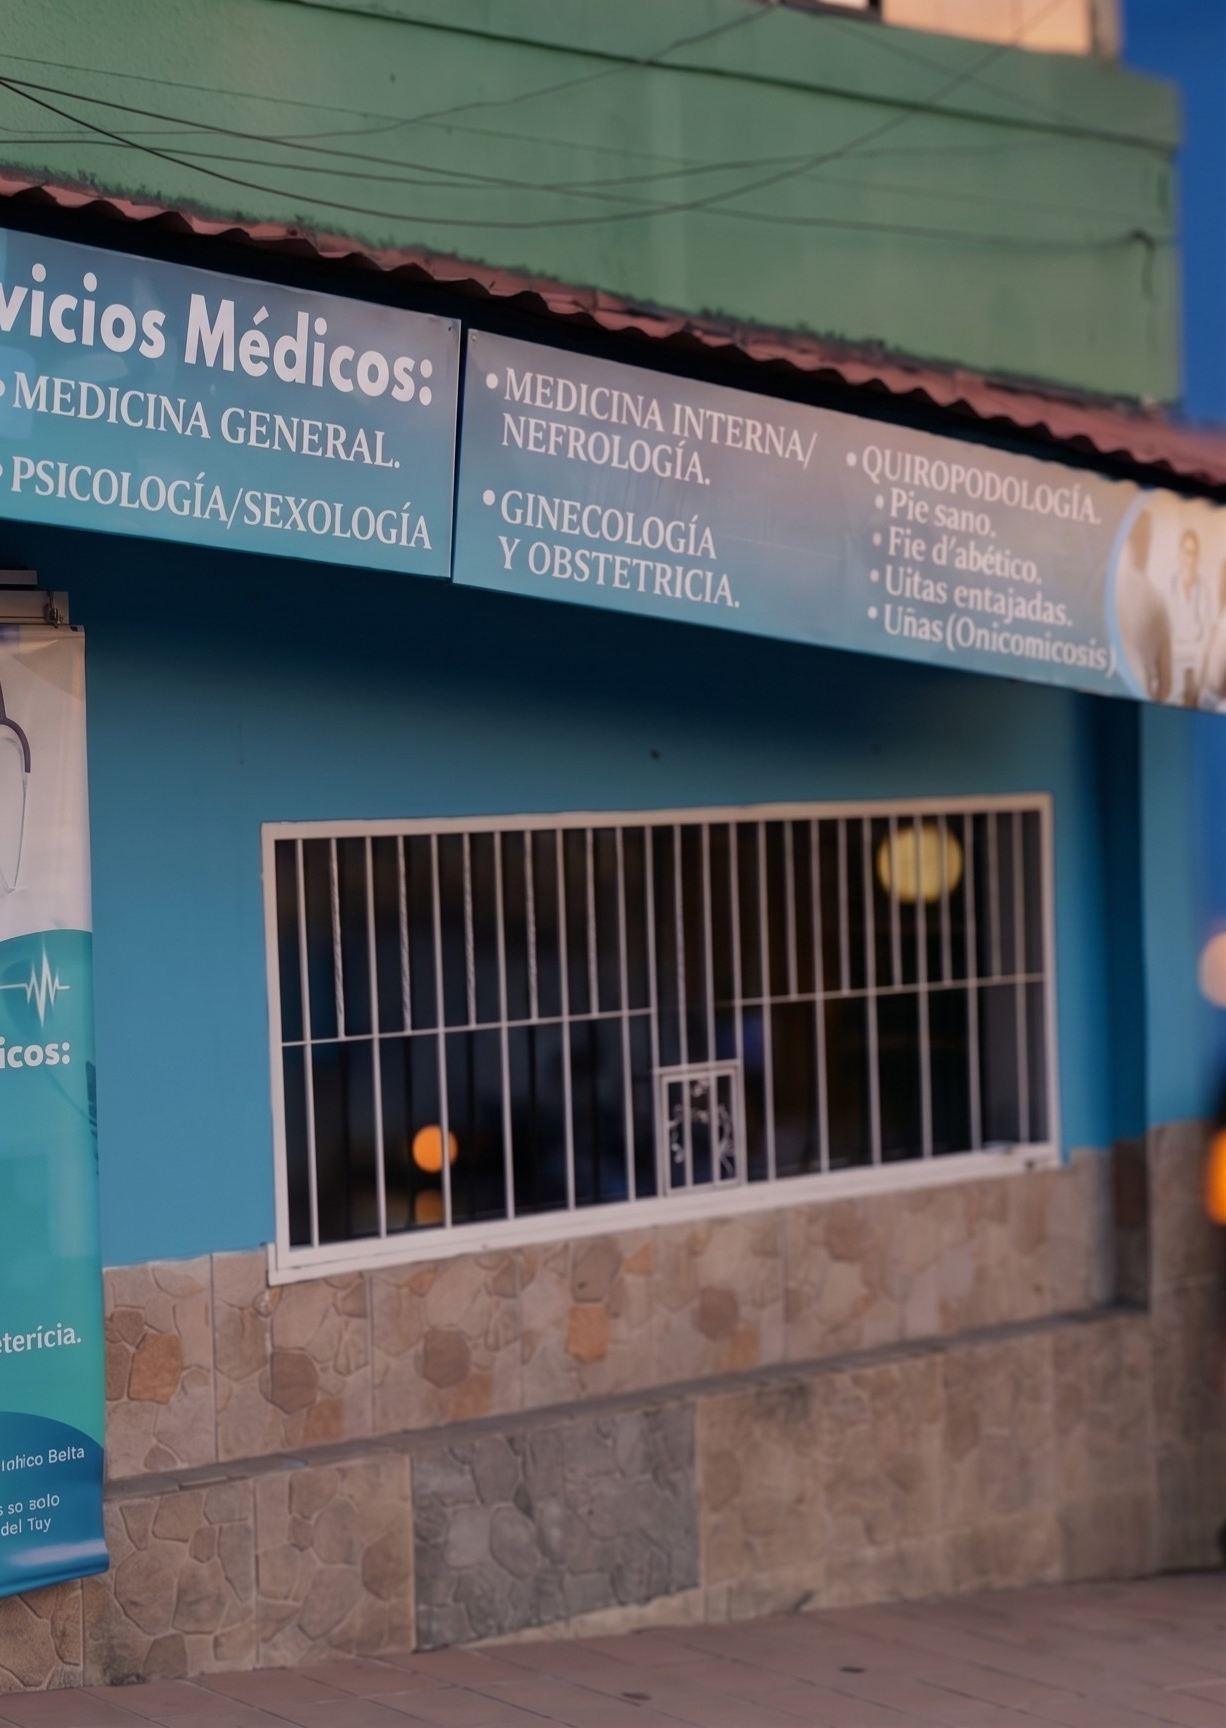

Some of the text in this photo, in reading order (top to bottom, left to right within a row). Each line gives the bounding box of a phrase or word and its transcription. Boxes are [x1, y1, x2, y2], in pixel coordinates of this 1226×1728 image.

[184, 293, 435, 407] Médicos:
[12, 369, 402, 470] MEDICINA GENERAL.
[500, 411, 712, 487] NEFROLOGÍA.
[503, 366, 818, 471] MEDICINA INTERNA/
[9, 454, 434, 551] PSICOLOGÍA/SEXOLOGÍA
[860, 443, 1103, 525] QUIROPODOLOGÍA.
[888, 486, 998, 539] Pie sano.
[499, 488, 718, 561] GINECOLOGÍA
[498, 535, 741, 609] Y OBSTETRICIA.
[953, 583, 1074, 628] entajadas.
[47, 1445, 86, 1465] Belta
[0, 1518, 23, 1537] del
